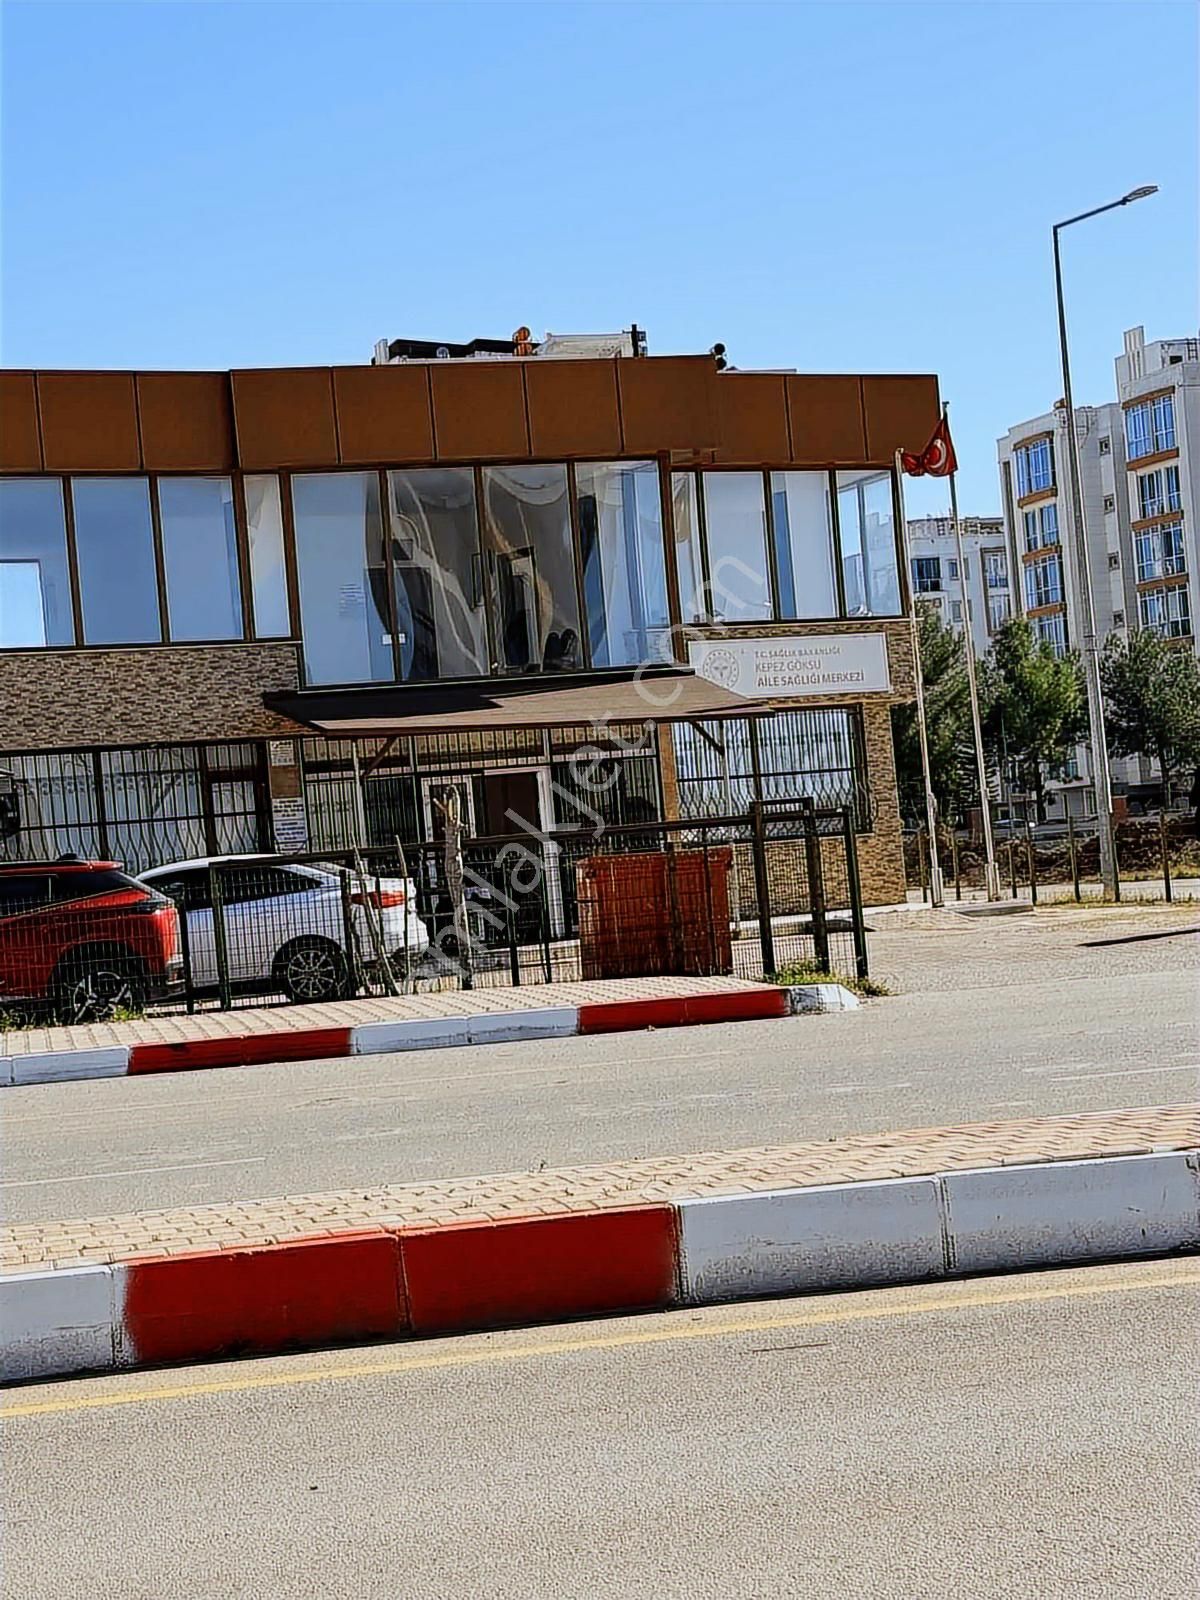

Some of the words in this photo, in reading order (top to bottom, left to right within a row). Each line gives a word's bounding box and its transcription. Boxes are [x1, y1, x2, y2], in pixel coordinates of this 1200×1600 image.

[755, 662, 785, 672] KEPEZ
[787, 659, 821, 671] GÖKSU
[757, 674, 780, 687] AİLE
[781, 671, 820, 686] SAĞLIĞI
[822, 669, 864, 683] MERKEZİ
